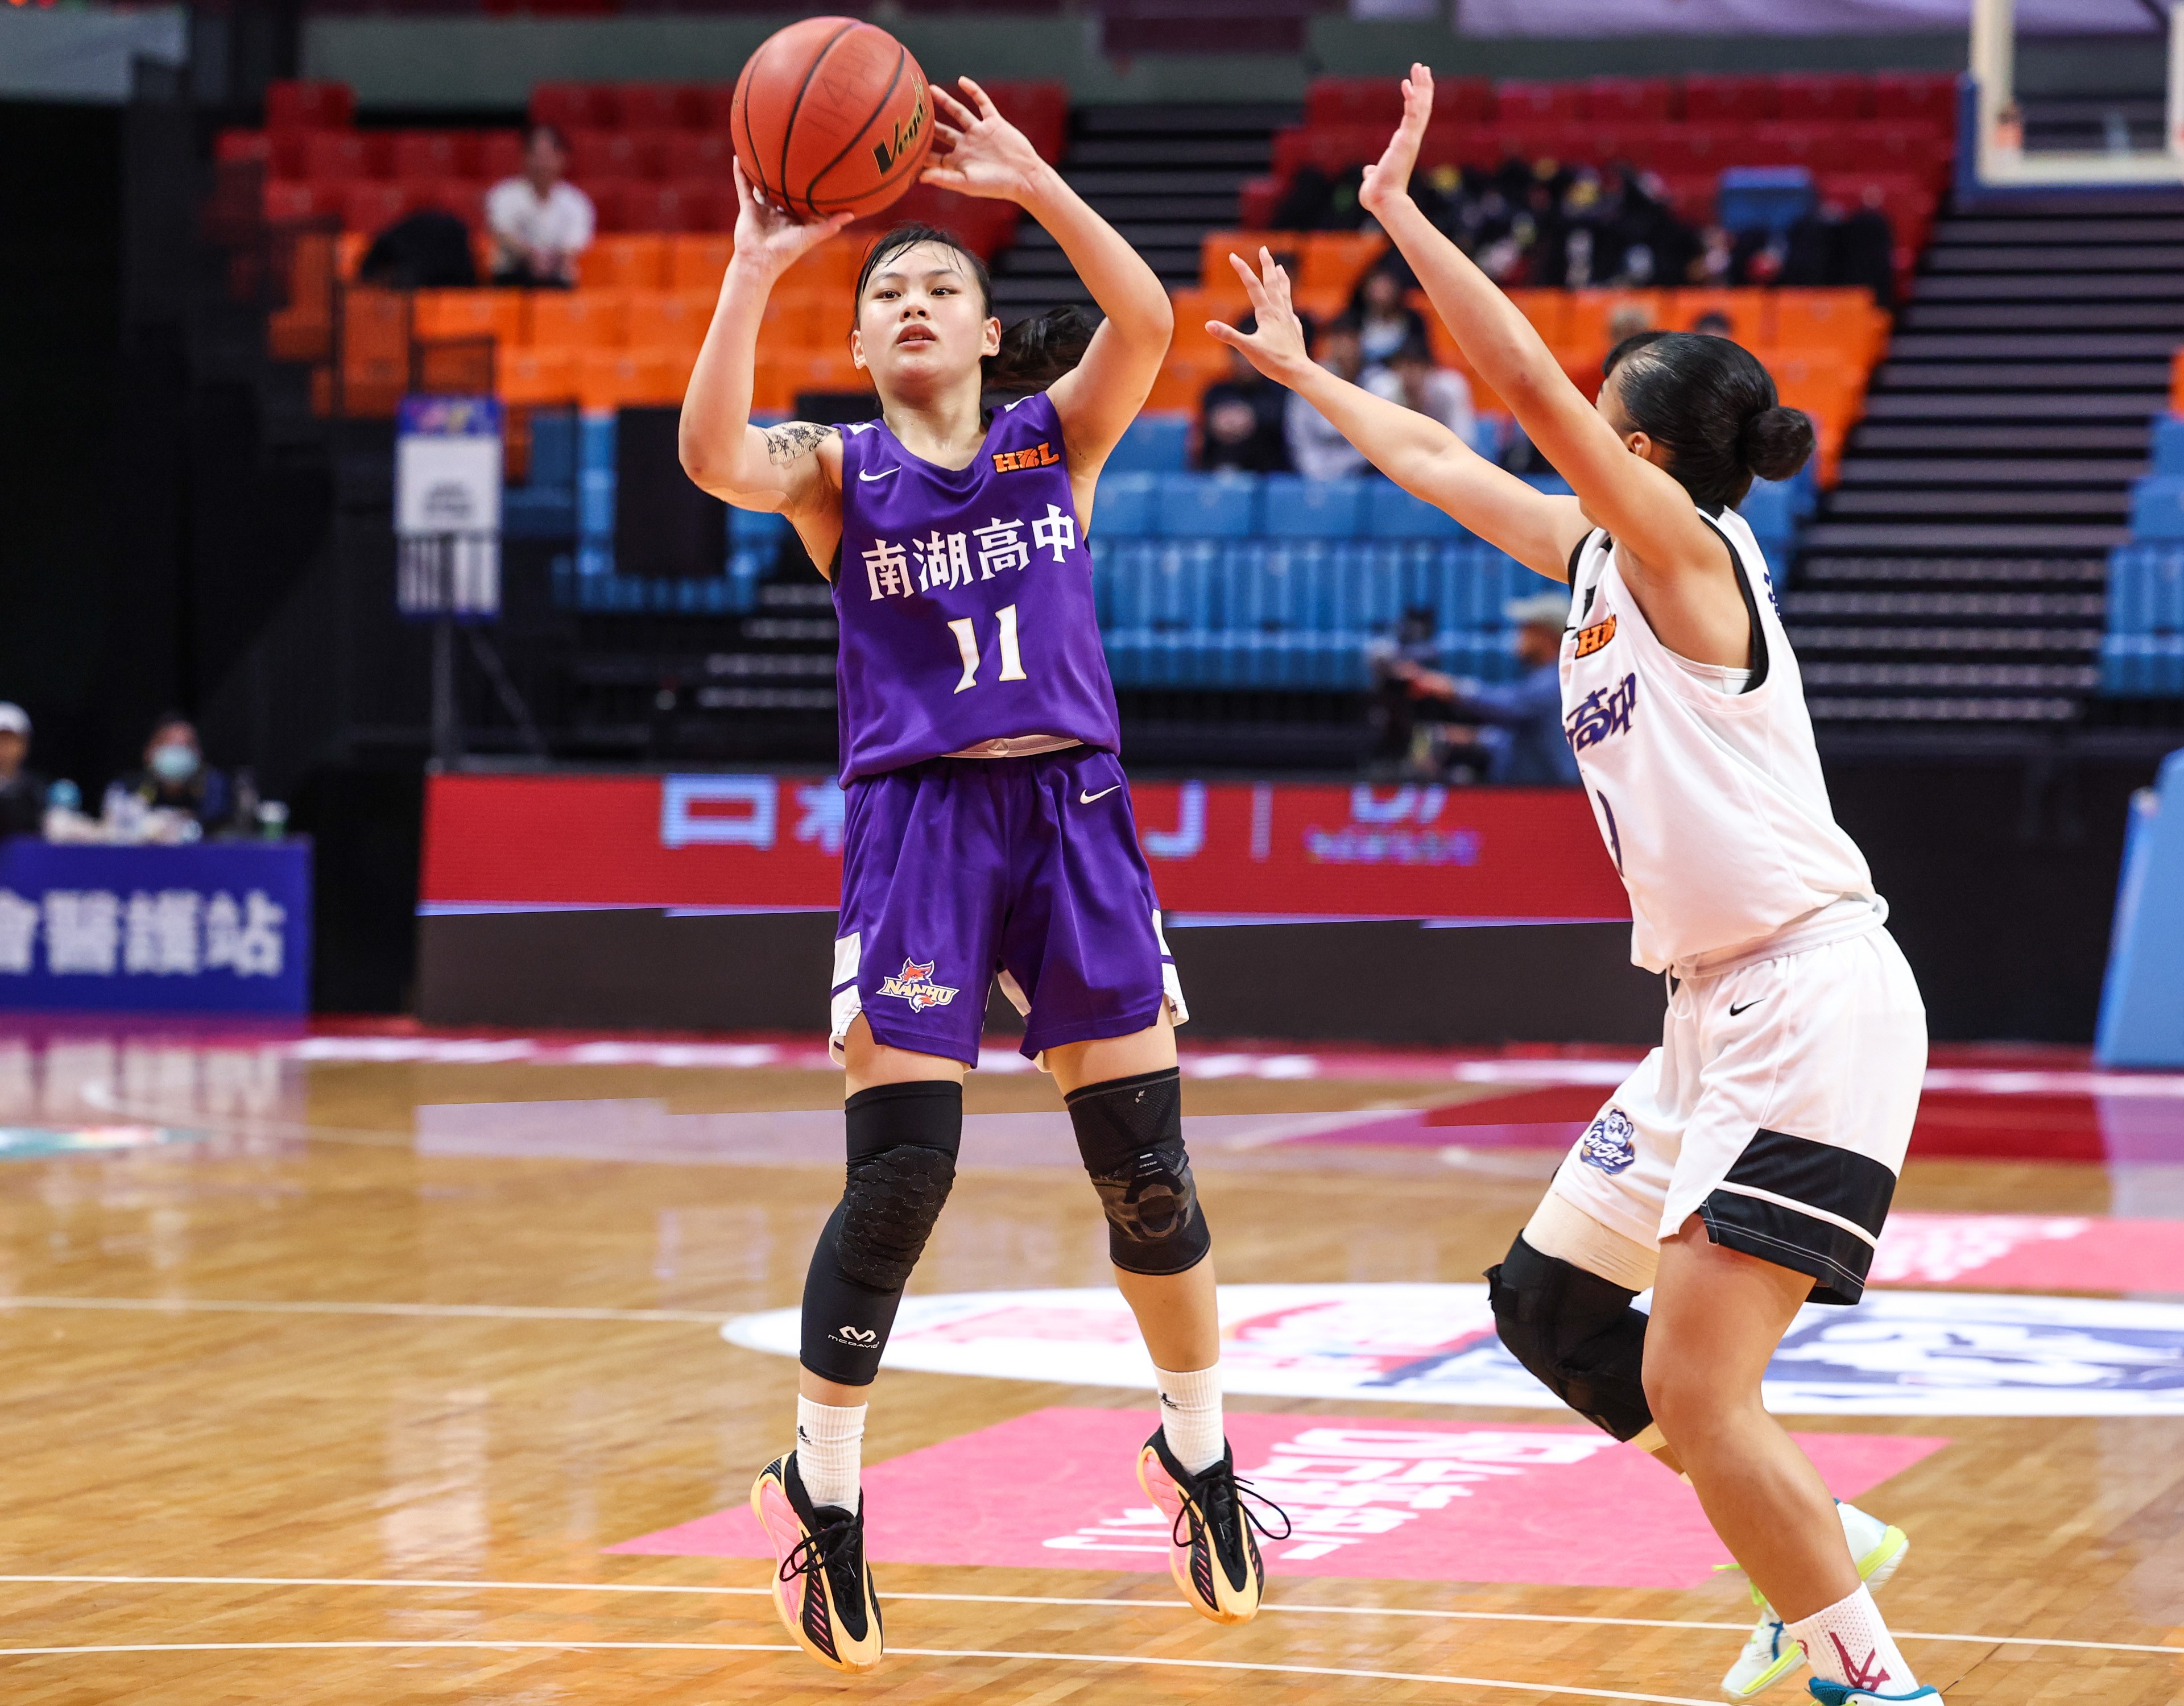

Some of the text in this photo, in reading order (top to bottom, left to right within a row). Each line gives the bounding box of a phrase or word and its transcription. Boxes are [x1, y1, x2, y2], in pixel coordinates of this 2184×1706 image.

[991, 442, 1060, 473] HBL
[862, 503, 1076, 601] 南湖高中
[947, 603, 1027, 694] 11
[1565, 672, 1636, 752] 高中
[882, 979, 956, 1003] NANHU
